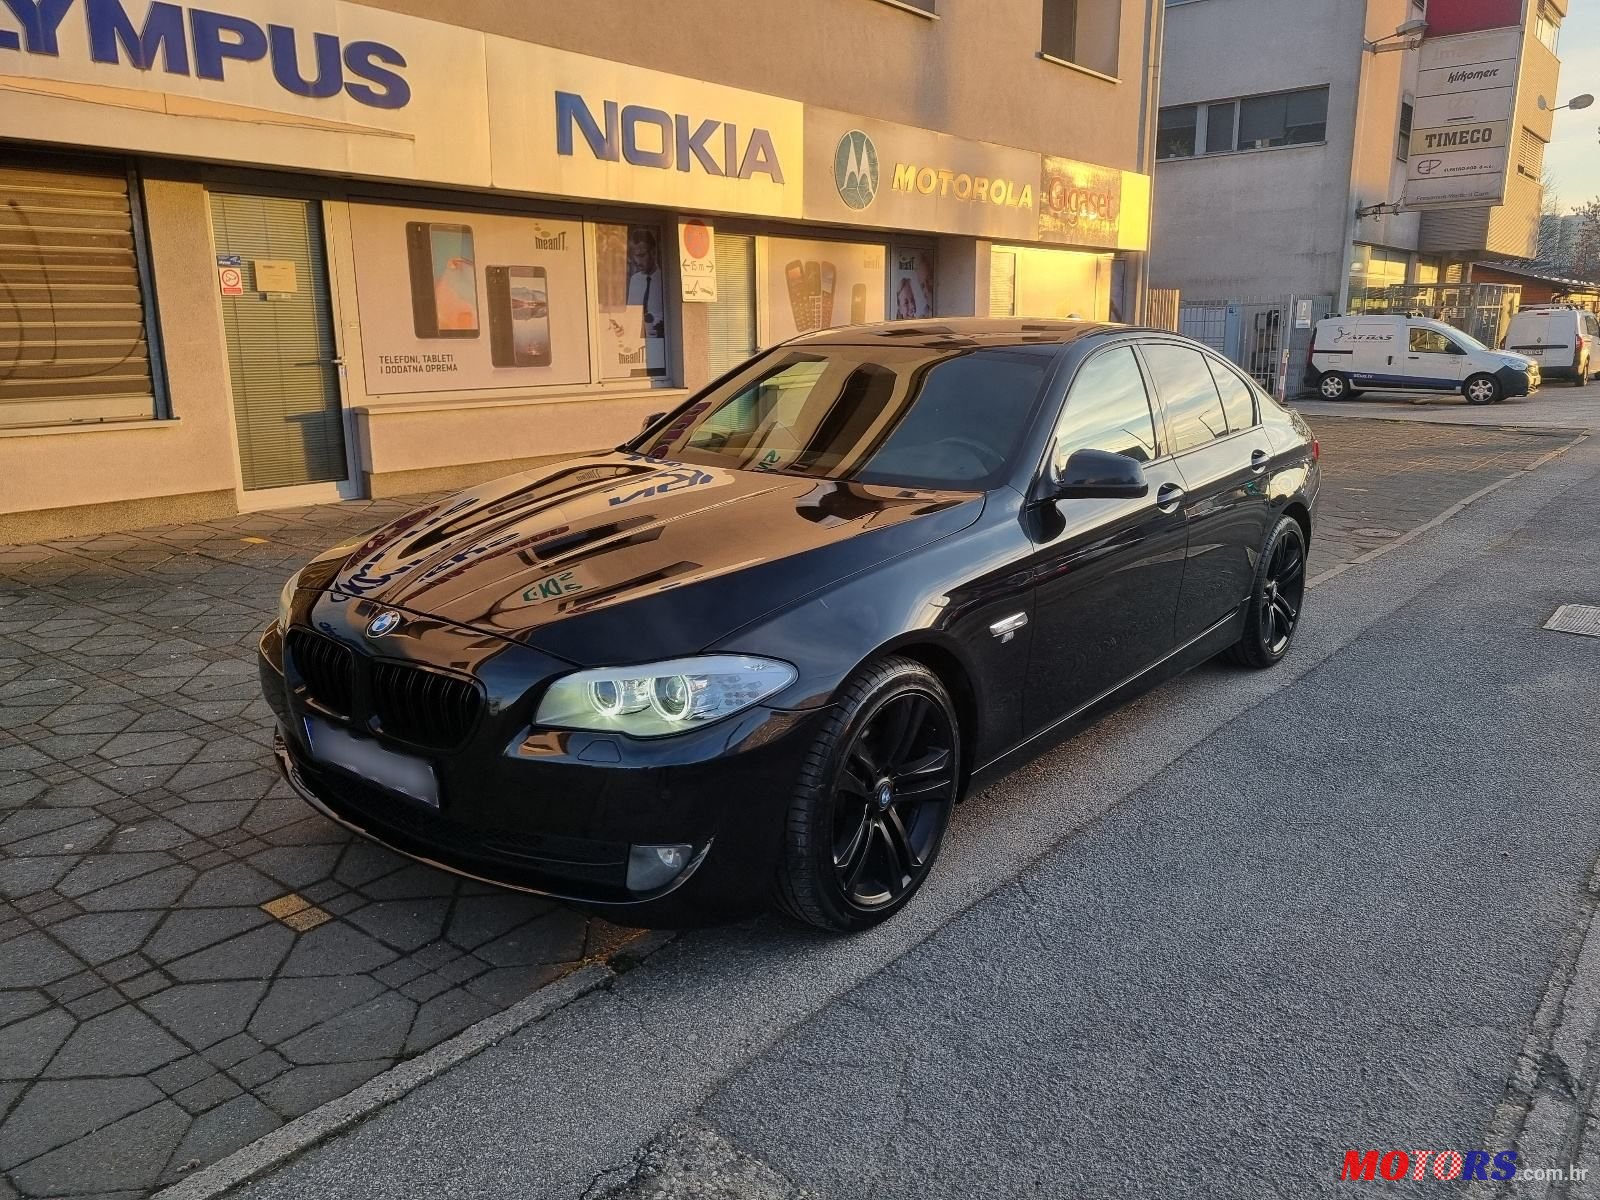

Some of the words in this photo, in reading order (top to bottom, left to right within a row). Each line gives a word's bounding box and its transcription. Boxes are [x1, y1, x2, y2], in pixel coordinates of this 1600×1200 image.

[554, 90, 785, 184] NOKIA
[1424, 127, 1493, 149] TIMECO
[891, 162, 1034, 210] MOTOROLA
[1048, 175, 1114, 226] Gigaset
[534, 231, 567, 251] meanIT
[378, 355, 421, 364] TELEFONI,
[422, 353, 454, 364] TABLETI
[385, 364, 424, 374] DODATNA
[425, 363, 458, 373] OPREMA
